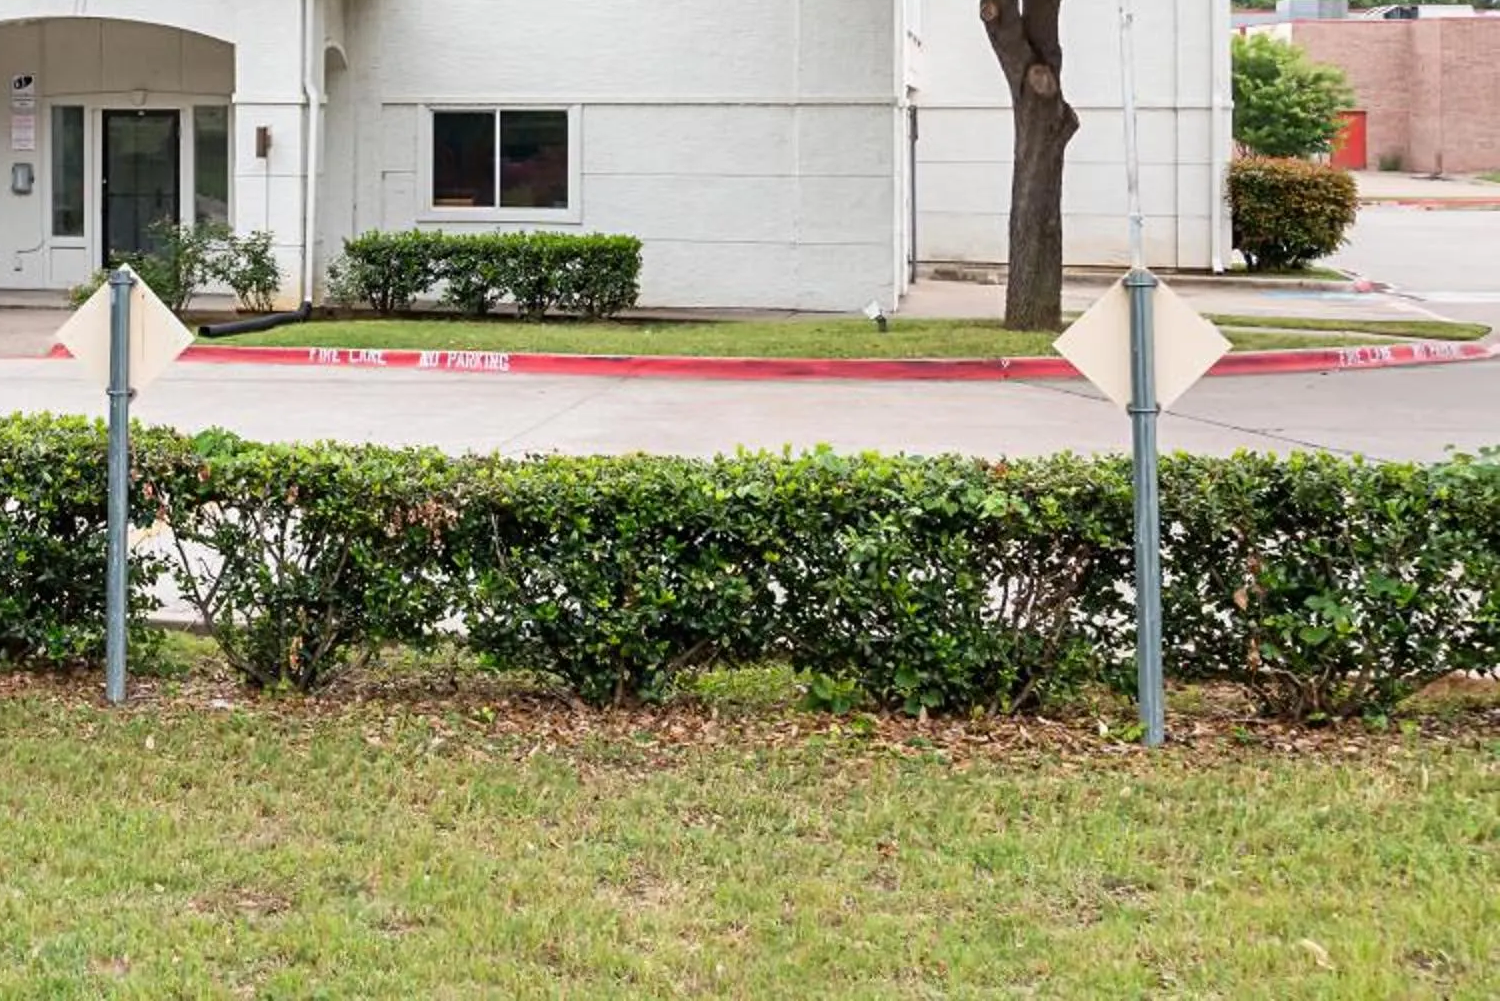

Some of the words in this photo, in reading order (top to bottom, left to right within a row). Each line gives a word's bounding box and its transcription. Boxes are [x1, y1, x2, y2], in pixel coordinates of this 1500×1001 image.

[349, 349, 387, 365] LANE
[419, 351, 439, 367] NO
[447, 352, 510, 371] PARKING
